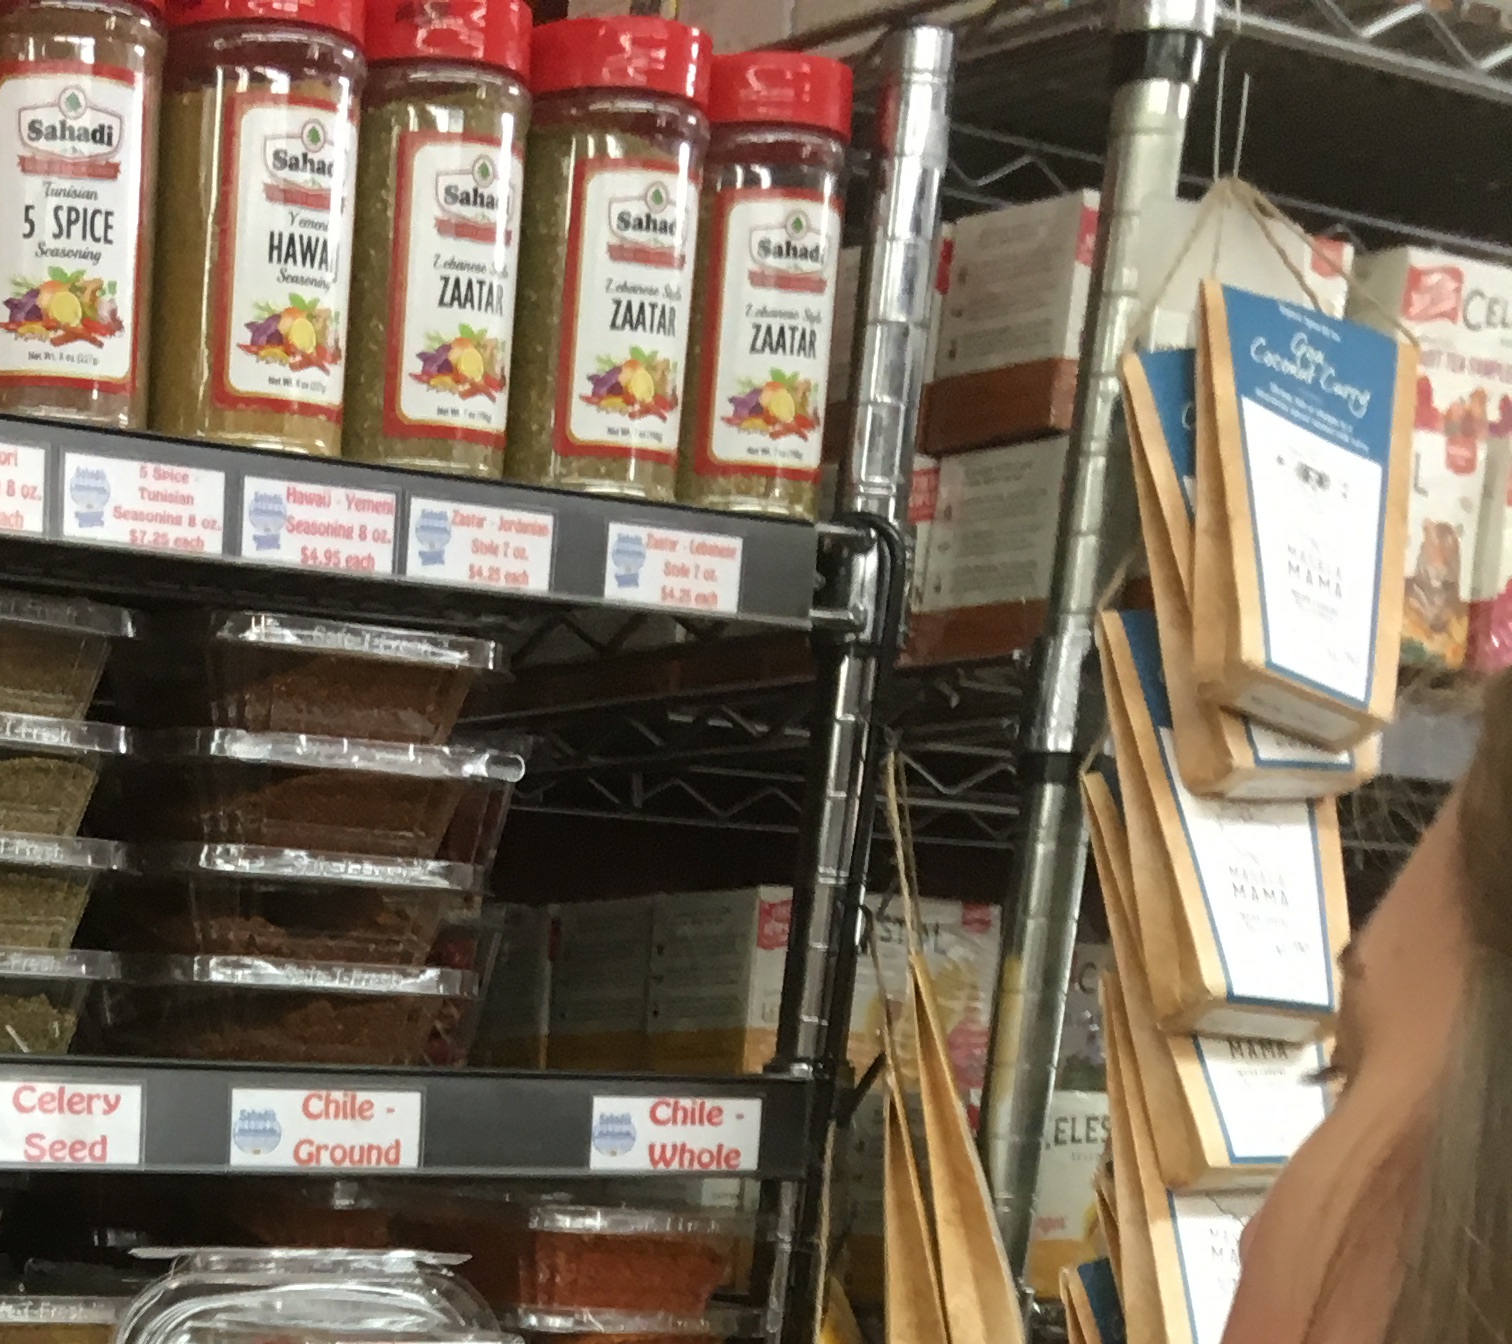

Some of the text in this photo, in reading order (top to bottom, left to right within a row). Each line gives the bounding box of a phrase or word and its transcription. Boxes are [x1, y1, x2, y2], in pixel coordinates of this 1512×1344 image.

[27, 119, 114, 147] Sahadi
[43, 181, 98, 201] Tunisian
[22, 204, 115, 245] 5 SPICE
[34, 242, 102, 266] Seasoning
[438, 275, 504, 316] ZAATAR
[610, 298, 676, 337] ZAATAR
[750, 323, 817, 360] ZAATAR
[1250, 336, 1316, 384] Coconut
[1320, 363, 1372, 418] Curry
[153, 466, 190, 485] Spice
[139, 486, 194, 506] Tunisian
[113, 506, 183, 526] Seasoning
[286, 516, 354, 540] Seasoning
[1232, 882, 1288, 906] MAMA
[12, 1084, 121, 1116] Celery
[302, 1090, 375, 1121] Chile
[649, 1098, 723, 1128] Chile
[23, 1133, 108, 1163] Seed
[293, 1137, 401, 1168] Ground
[647, 1141, 741, 1170] Whole
